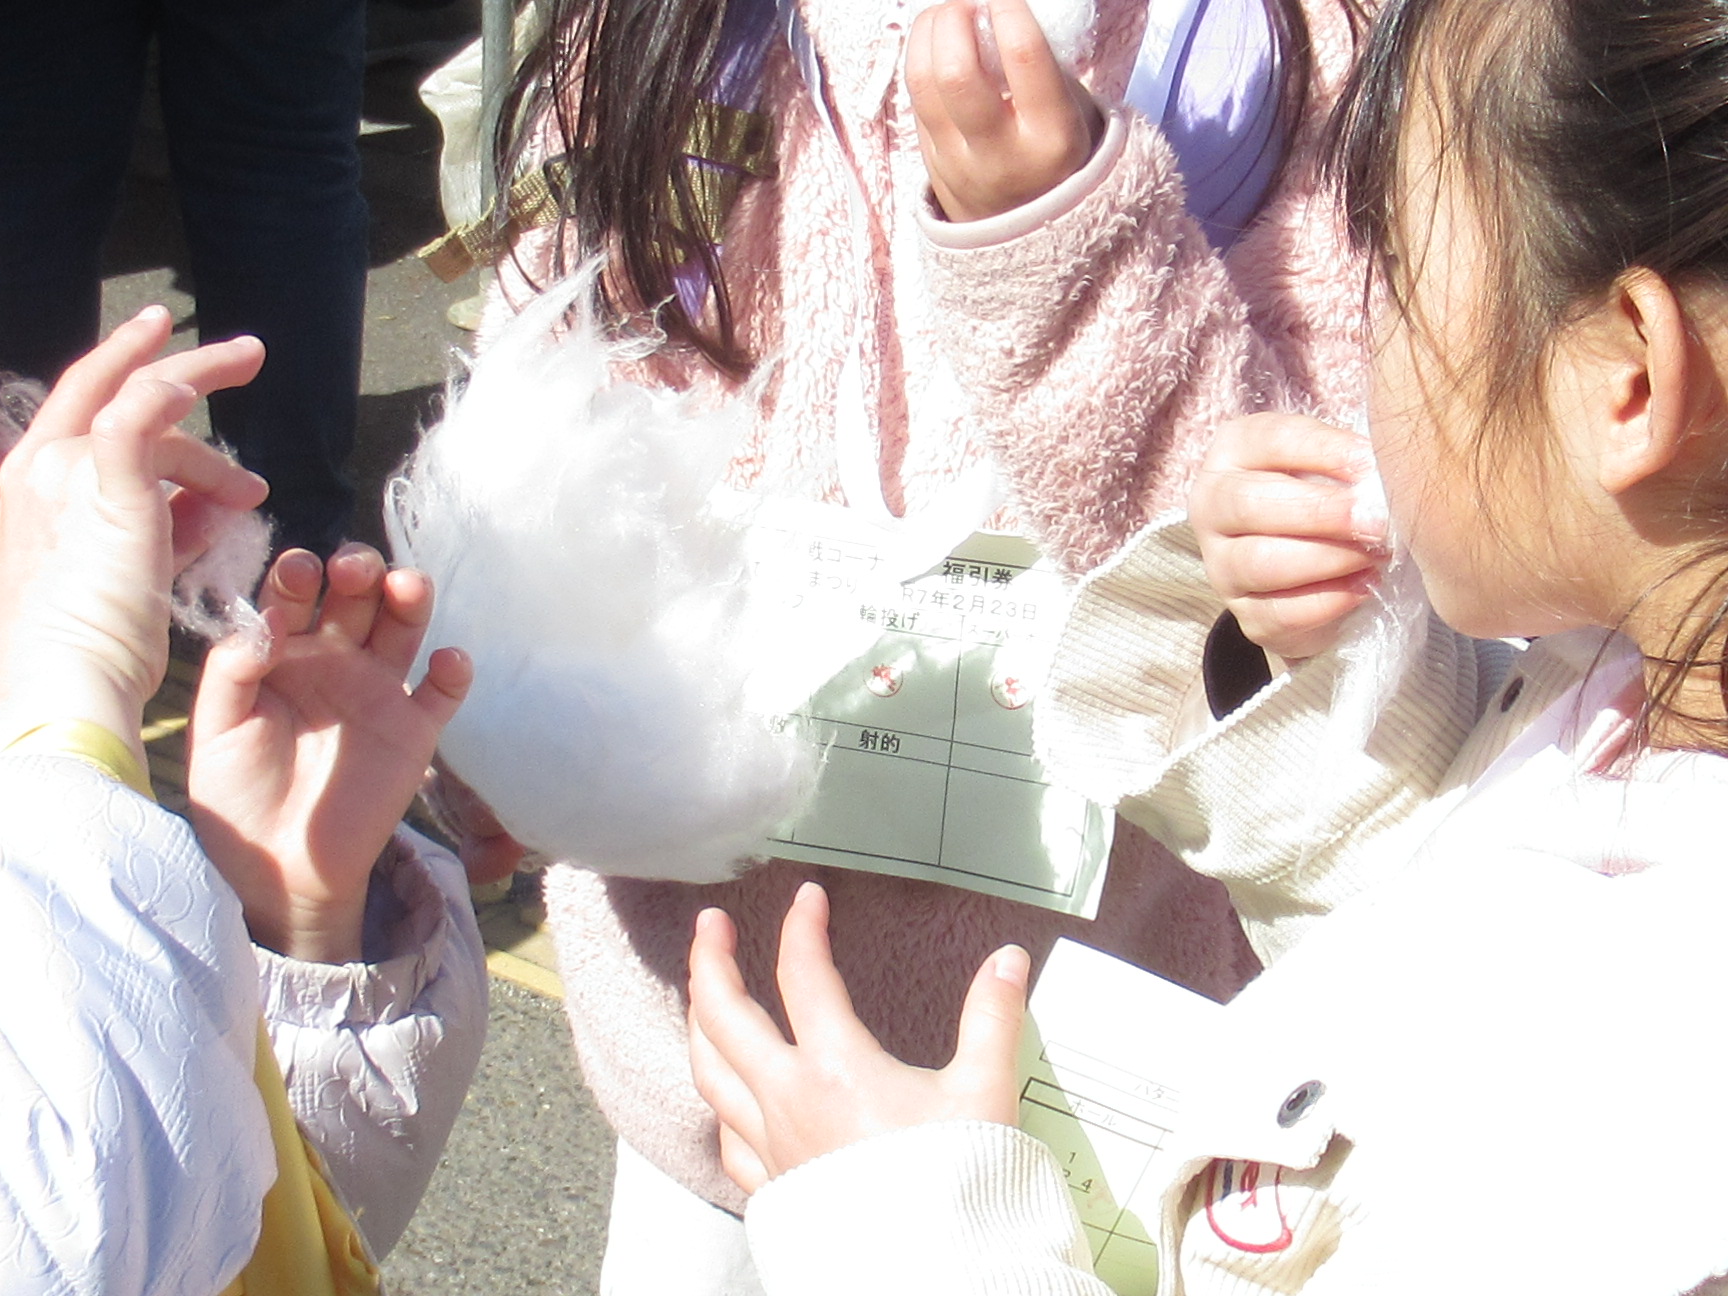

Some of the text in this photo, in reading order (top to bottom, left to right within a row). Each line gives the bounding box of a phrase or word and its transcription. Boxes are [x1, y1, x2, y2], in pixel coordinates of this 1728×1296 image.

[808, 570, 858, 594] まつり
[941, 560, 1014, 591] 福引券
[859, 603, 920, 630] 輪投げ
[858, 729, 901, 754] 射的
